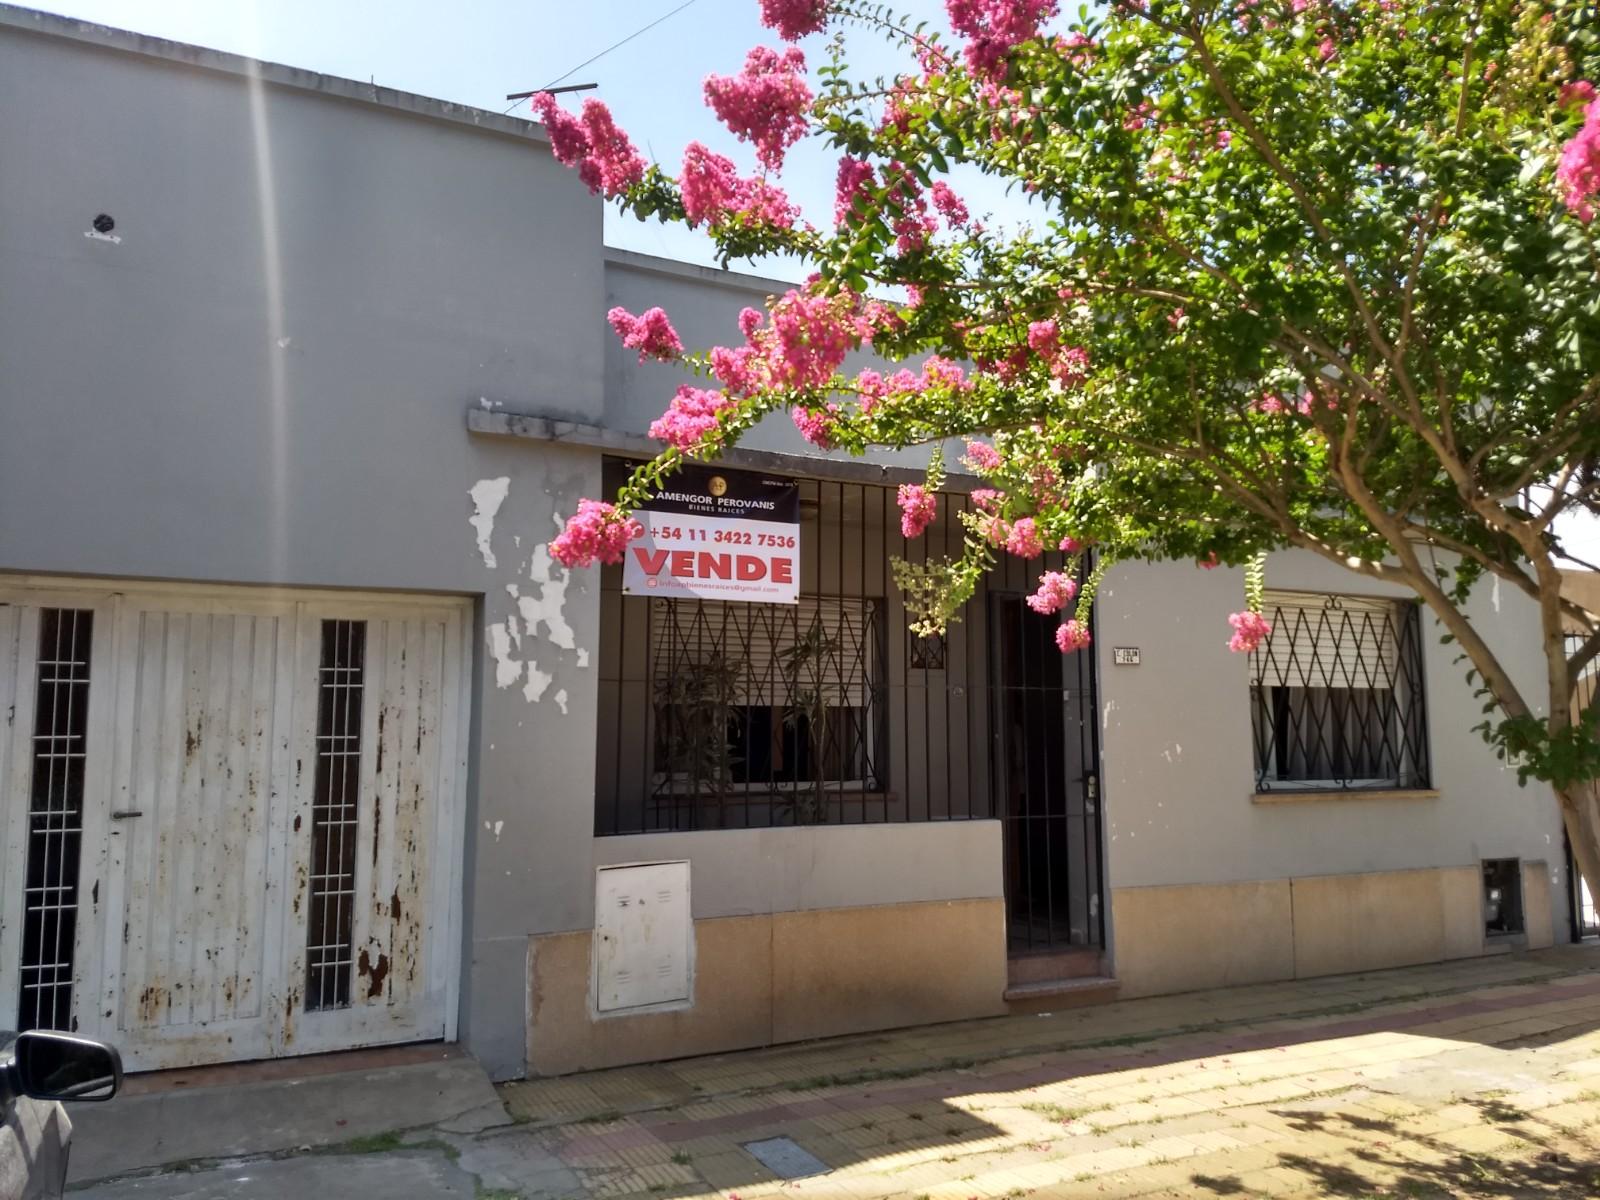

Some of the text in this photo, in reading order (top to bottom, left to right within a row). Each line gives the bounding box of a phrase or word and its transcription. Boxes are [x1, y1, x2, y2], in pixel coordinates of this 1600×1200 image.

[656, 491, 775, 511] AMENGOR PEROVANIS
[688, 504, 745, 515] BIENES RAICES
[650, 527, 796, 549] +54 11 3422 7536
[632, 547, 793, 584] VENDE
